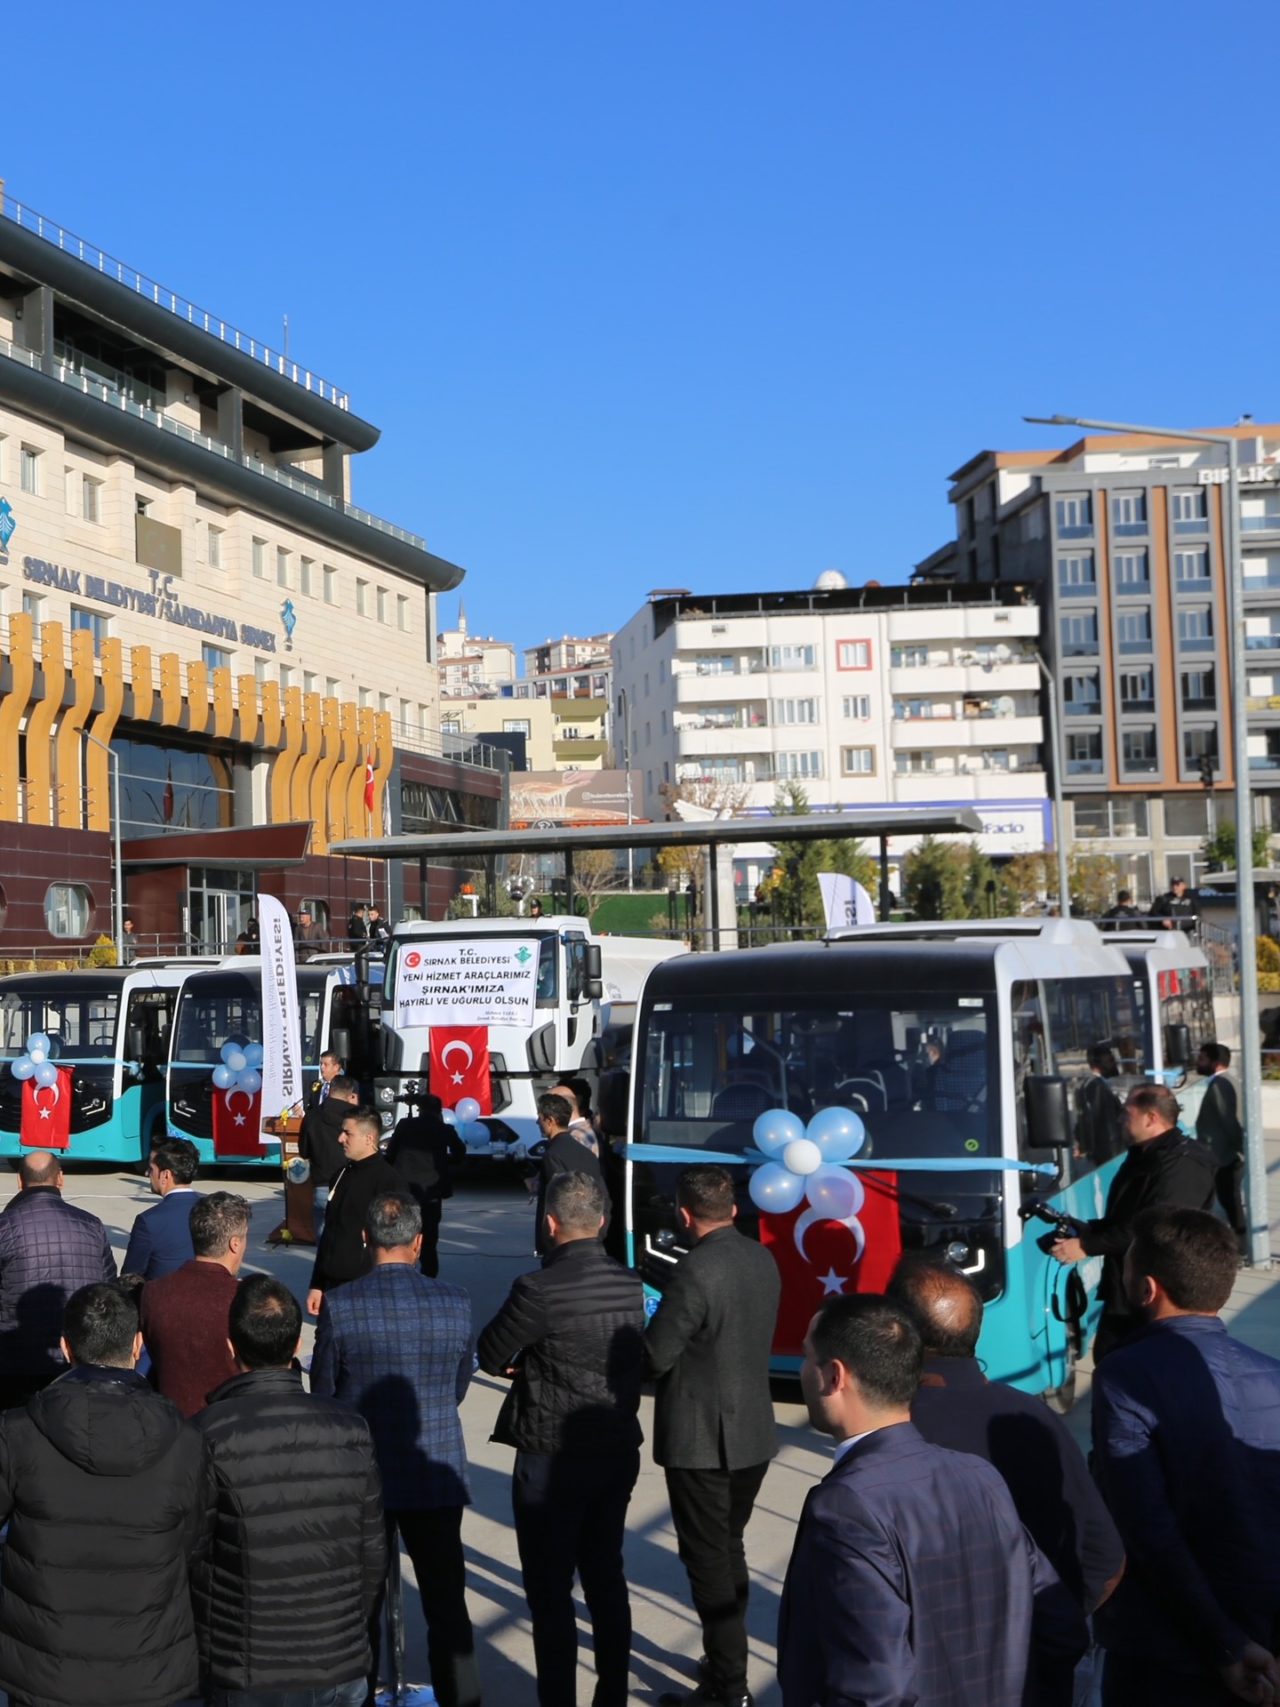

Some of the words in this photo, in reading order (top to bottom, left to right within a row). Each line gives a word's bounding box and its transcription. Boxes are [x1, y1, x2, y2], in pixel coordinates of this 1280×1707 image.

[148, 569, 178, 601] T.C.
[459, 948, 477, 956] T.C.
[403, 973, 424, 982] YENİ
[426, 971, 461, 981] HİZMET
[464, 970, 531, 980] ARAÇLARIMIZ
[400, 997, 434, 1008] HAYIRLI
[436, 997, 449, 1005] VE
[452, 996, 491, 1005] UĞURLU
[494, 996, 529, 1006] OLSUN
